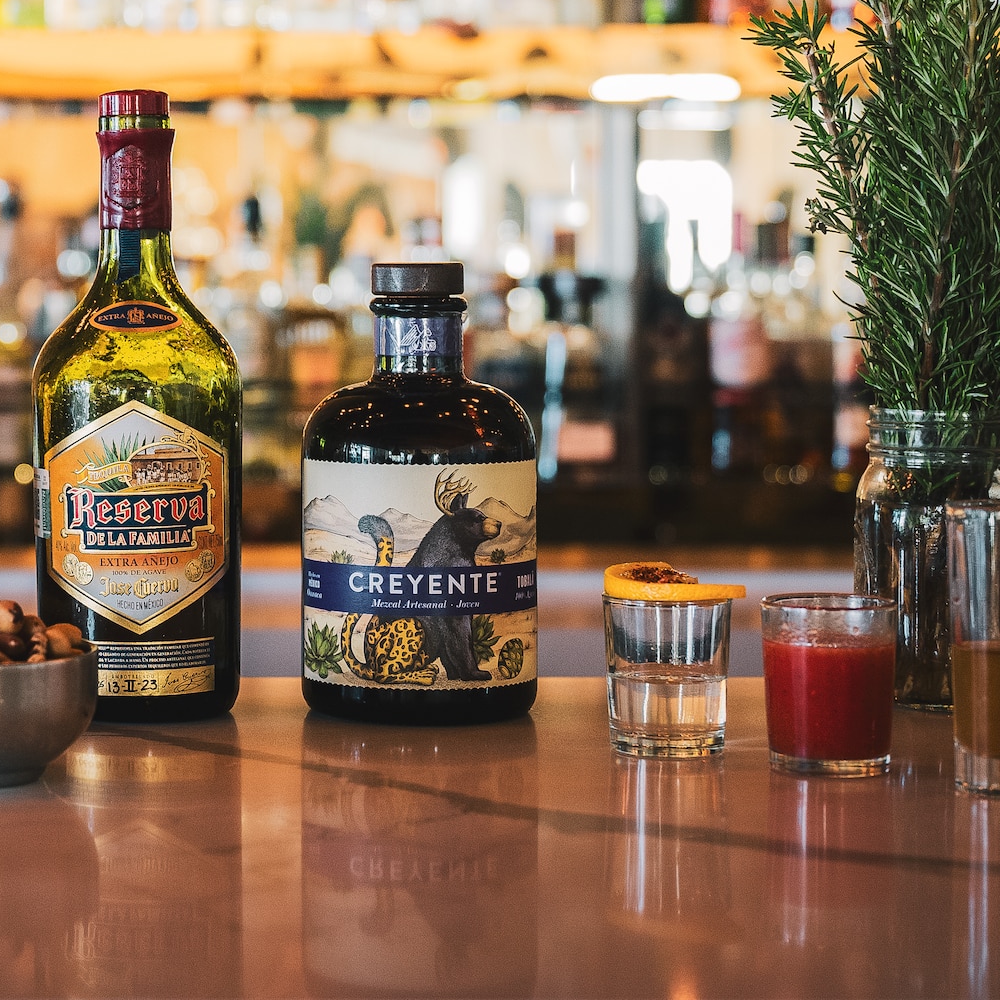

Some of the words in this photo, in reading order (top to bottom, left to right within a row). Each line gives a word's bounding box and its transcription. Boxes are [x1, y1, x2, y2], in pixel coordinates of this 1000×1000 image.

[98, 313, 125, 322] EXTRA
[146, 312, 174, 322] AÑEJO
[88, 464, 129, 480] TEQUILA
[69, 487, 206, 529] Reserva
[86, 530, 106, 546] DE
[108, 530, 128, 546] LA
[129, 530, 191, 546] FAMILIA
[100, 558, 138, 567] EXTRA
[142, 555, 179, 567] AÑEJO
[99, 576, 132, 597] Jose
[348, 571, 499, 596] CREYENTE
[116, 599, 135, 610] HECHO
[136, 601, 143, 610] EN
[143, 599, 164, 610] MÉXICO
[371, 598, 401, 609] Mezcal
[403, 598, 447, 609] Artesanal
[456, 600, 480, 609] Joven
